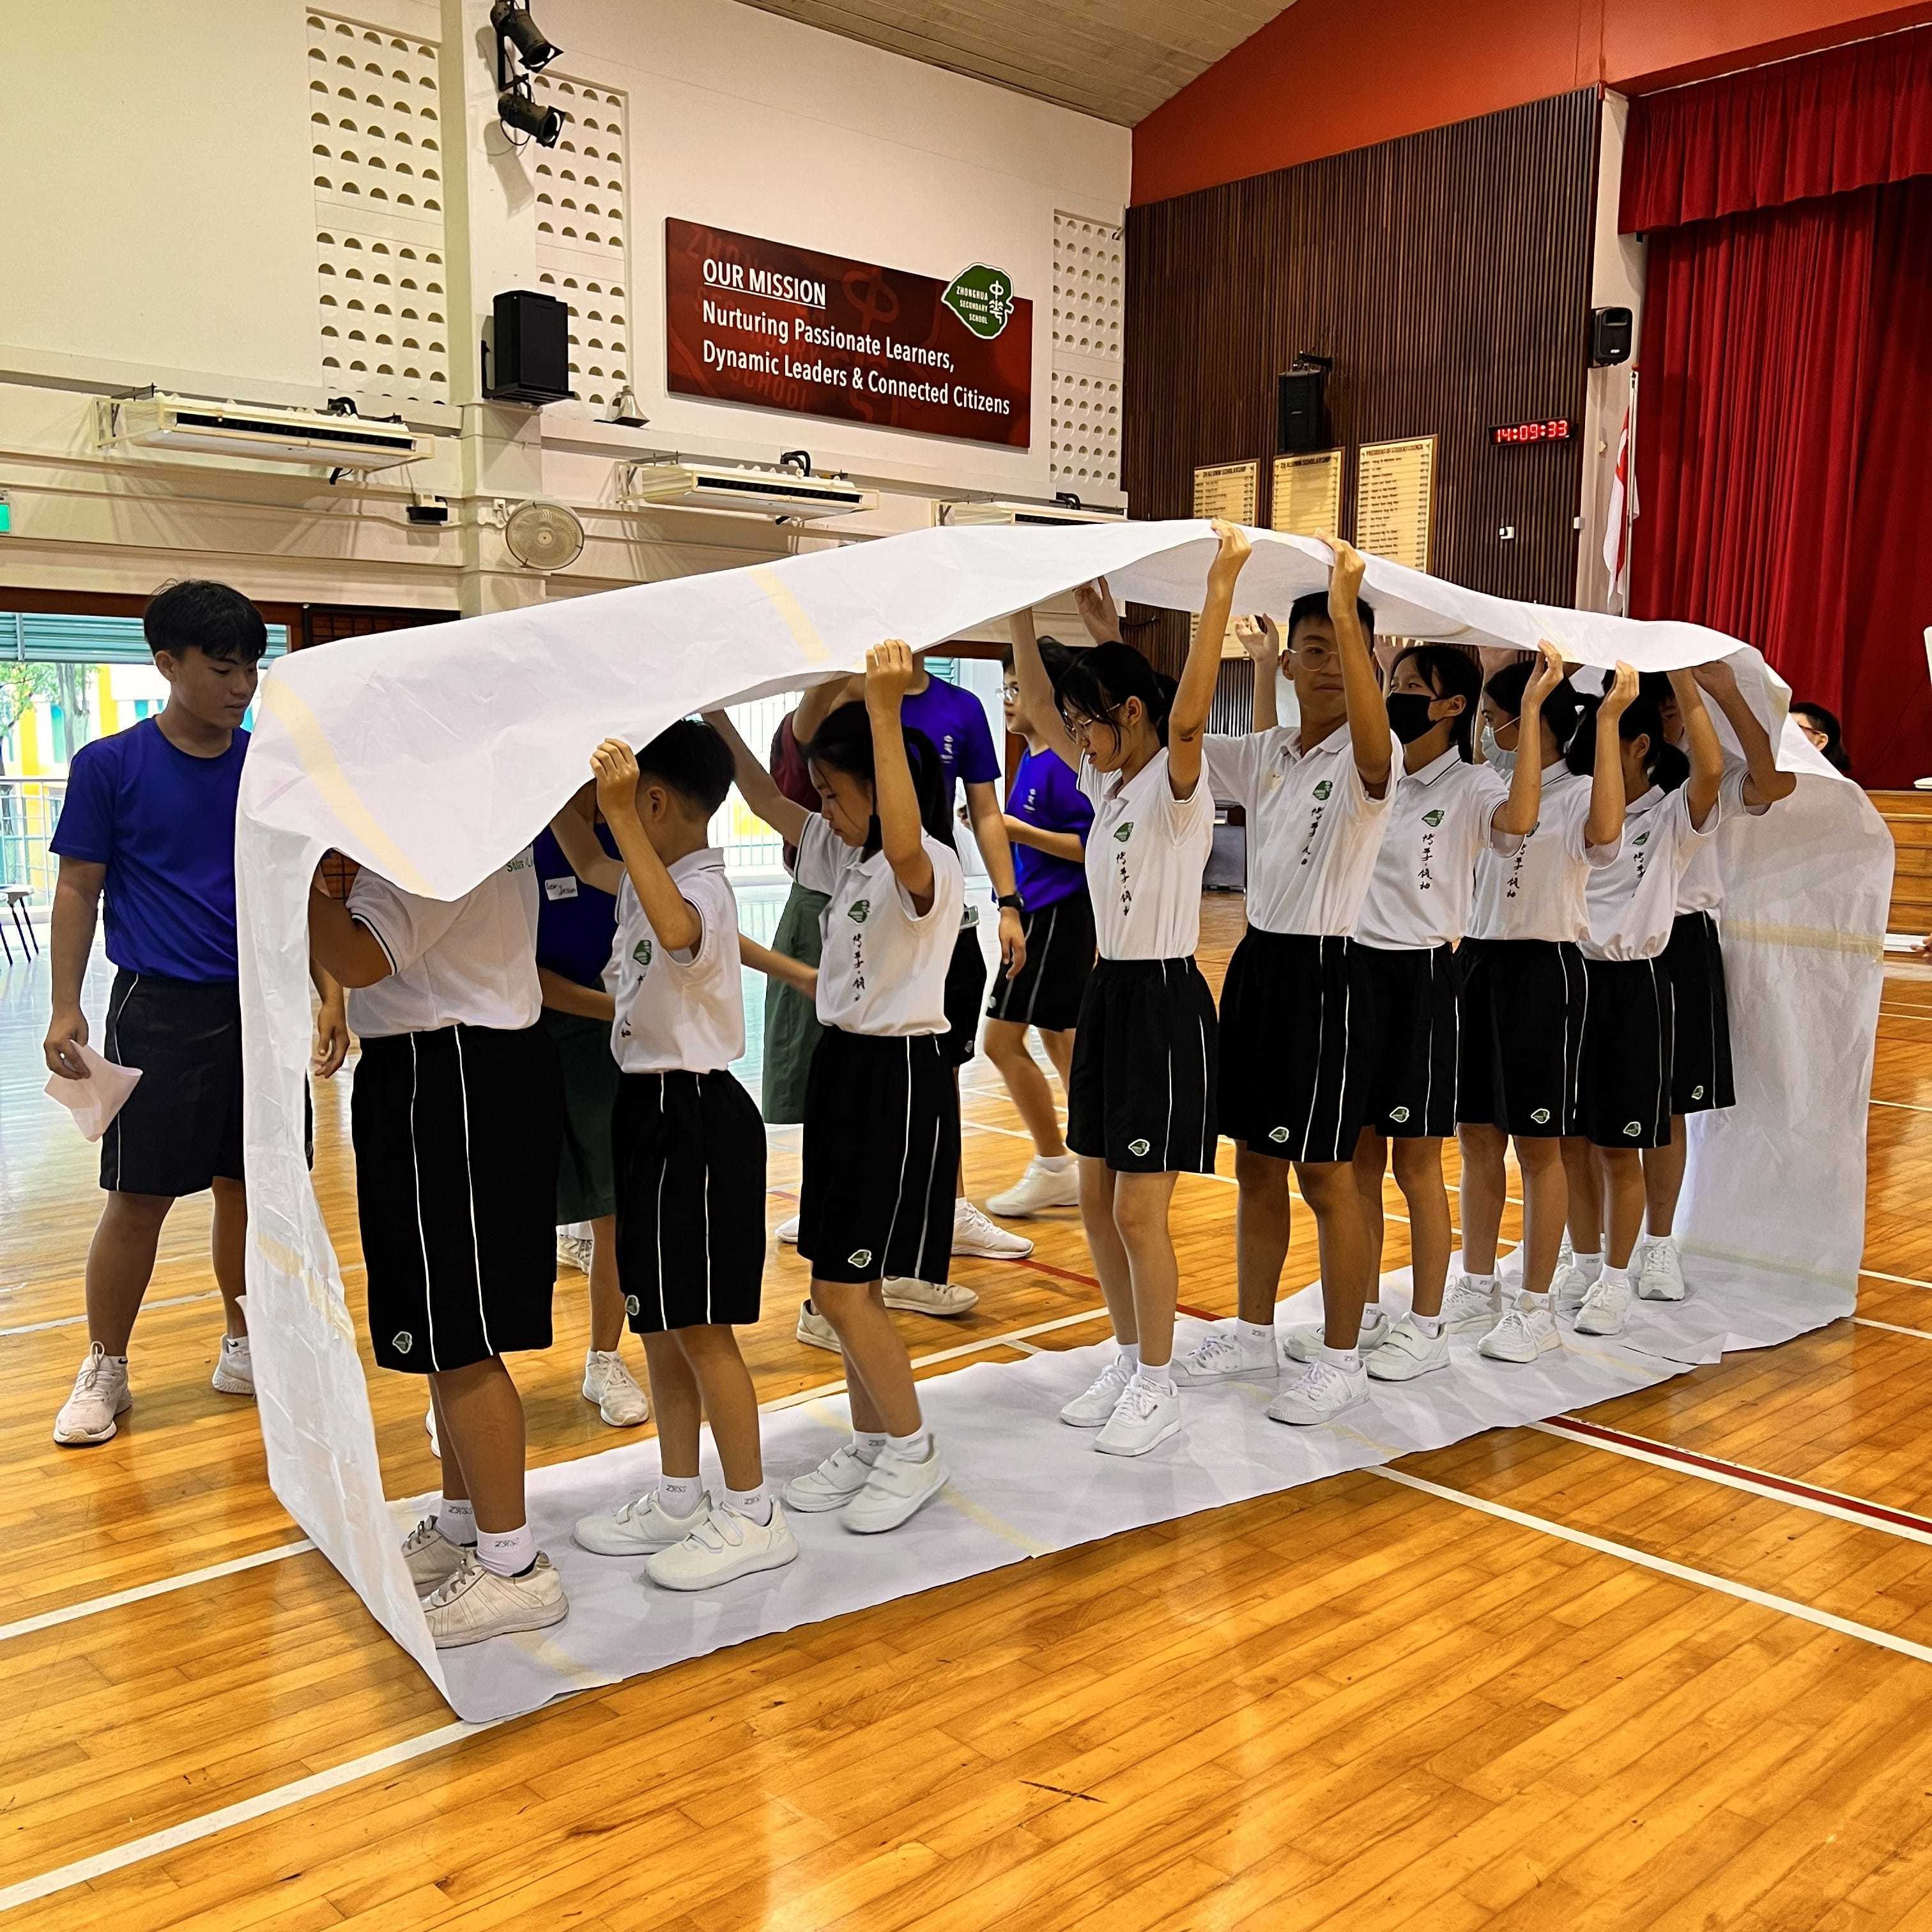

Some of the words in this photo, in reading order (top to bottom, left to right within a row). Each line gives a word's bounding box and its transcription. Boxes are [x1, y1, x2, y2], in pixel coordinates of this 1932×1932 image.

[703, 259, 743, 285] OUR
[749, 268, 825, 305] MISSION
[956, 286, 988, 301] ZHONGHUA
[960, 300, 988, 312] SECONDARY
[969, 313, 988, 325] SCHOOL
[703, 300, 788, 343] Nurturing
[795, 318, 880, 355] Passionate
[886, 336, 954, 372] Learners,
[703, 339, 779, 375] Dynamic
[785, 355, 846, 387] Leaders
[852, 370, 863, 390] &
[868, 371, 948, 404] Connected
[953, 386, 1009, 415] Citizens
[1498, 420, 1567, 442] 14:09:33
